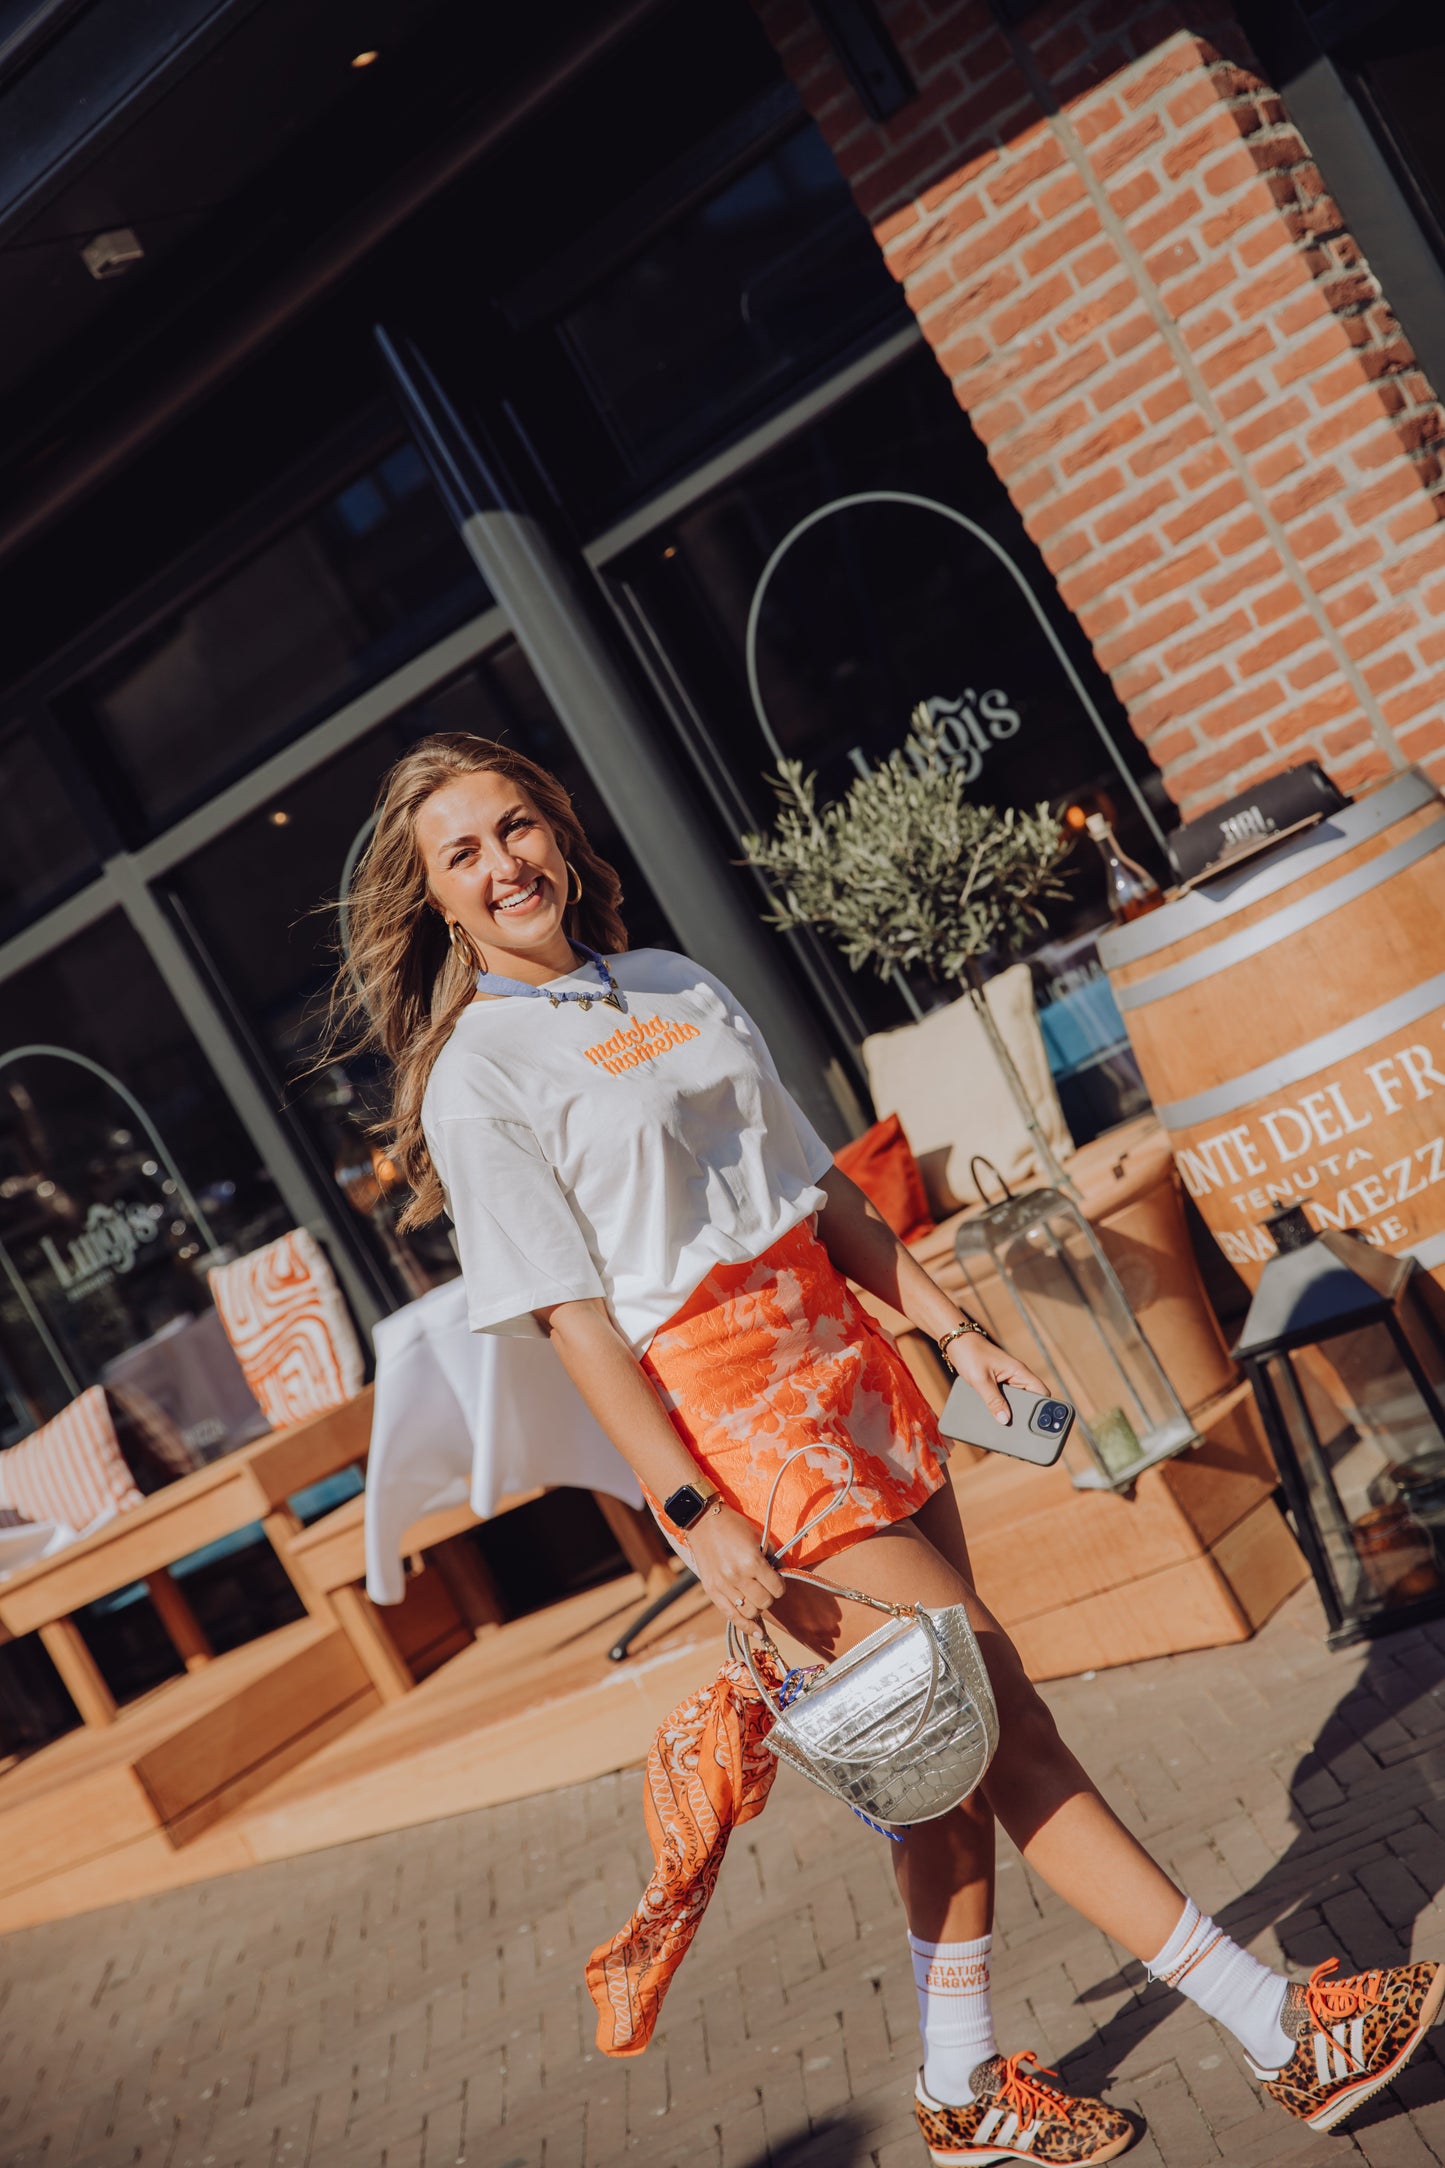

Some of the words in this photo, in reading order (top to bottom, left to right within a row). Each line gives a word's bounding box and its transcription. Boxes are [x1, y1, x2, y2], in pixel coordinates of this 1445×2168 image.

[583, 1015, 670, 1065] matcha
[602, 1022, 701, 1077] moments
[1259, 1082, 1373, 1163] DEL
[1364, 1044, 1445, 1115] FR
[1230, 1147, 1374, 1214] TENUTA
[928, 1961, 986, 1977] STATION
